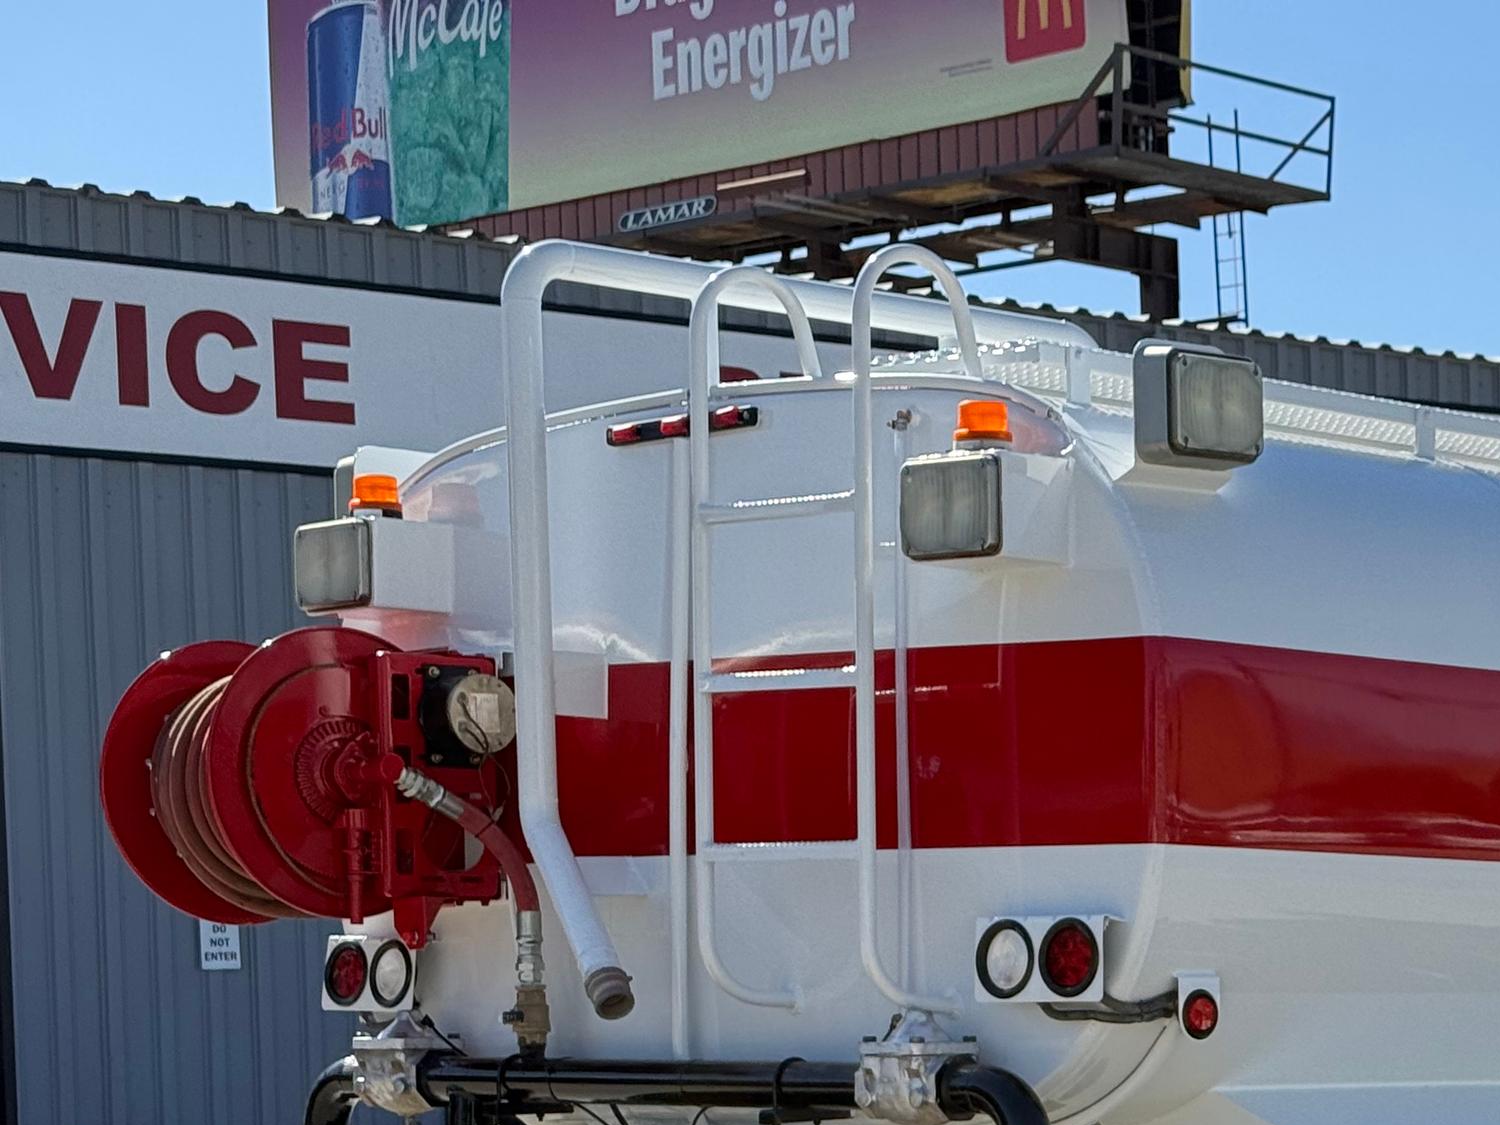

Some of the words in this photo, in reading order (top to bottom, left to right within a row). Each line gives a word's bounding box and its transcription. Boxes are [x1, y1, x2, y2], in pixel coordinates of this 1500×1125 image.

[651, 0, 855, 101] Energizer
[351, 106, 387, 140] Bull
[626, 198, 706, 230] LAMAR
[0, 291, 356, 426] VICE
[210, 937, 230, 948] NOT
[212, 924, 227, 934] DO
[204, 951, 238, 961] ENTER
